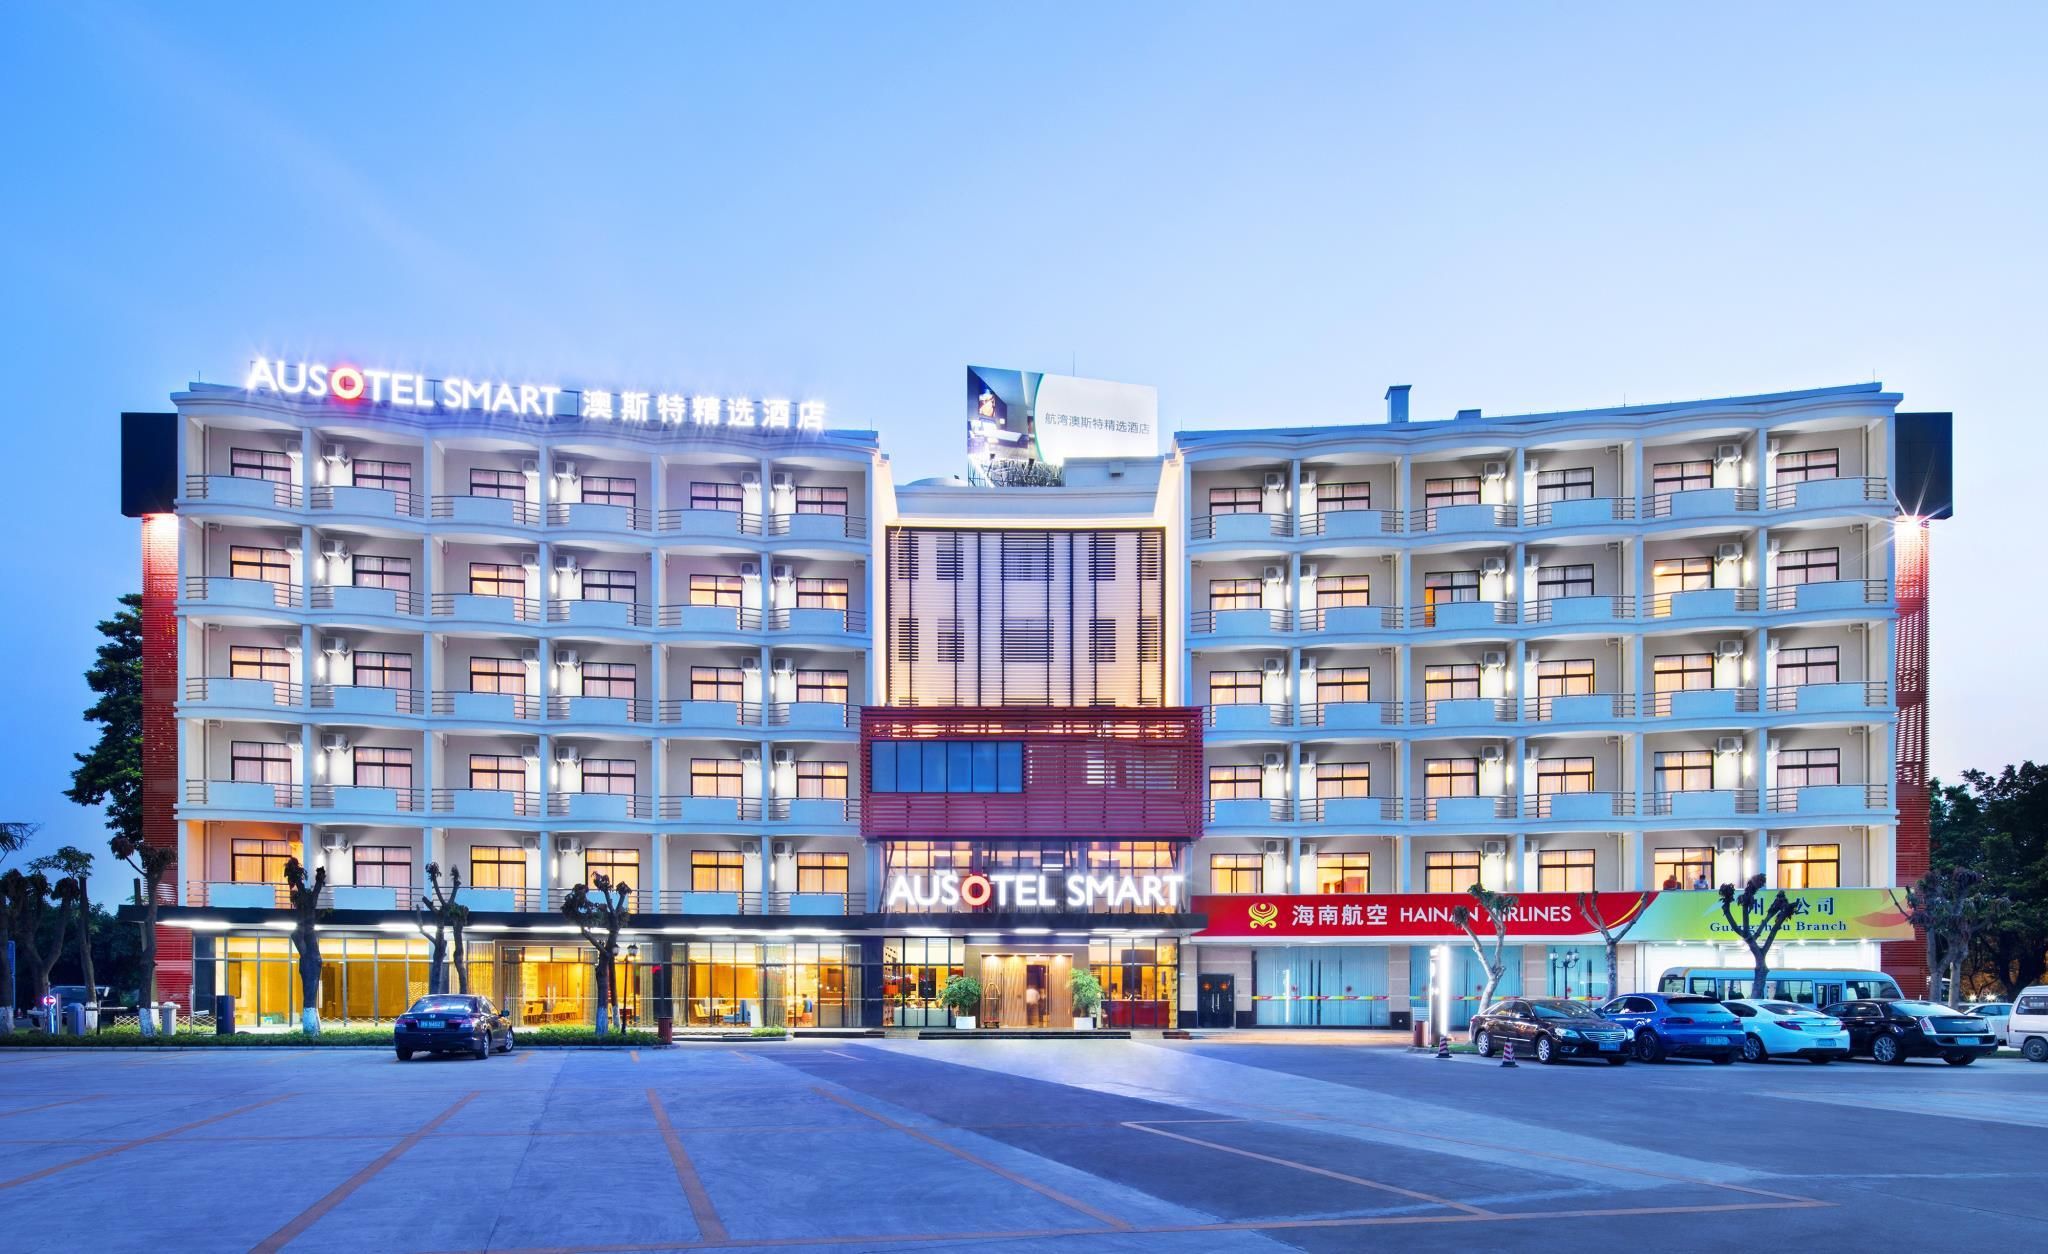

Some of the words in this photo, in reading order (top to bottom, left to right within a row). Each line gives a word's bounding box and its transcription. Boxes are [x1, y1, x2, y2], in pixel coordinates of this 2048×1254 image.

[246, 357, 434, 406] AUSOTEL
[443, 378, 561, 416] SMART
[582, 390, 826, 429] 澳斯特精选酒店
[1045, 412, 1151, 435] 航湾澳斯特精选酒店
[888, 874, 1055, 907] AUSOTEL
[1067, 874, 1185, 907] SMART
[1292, 904, 1388, 926] 海南航空
[1400, 906, 1479, 923] HAINN
[1796, 920, 1847, 931] Branch
